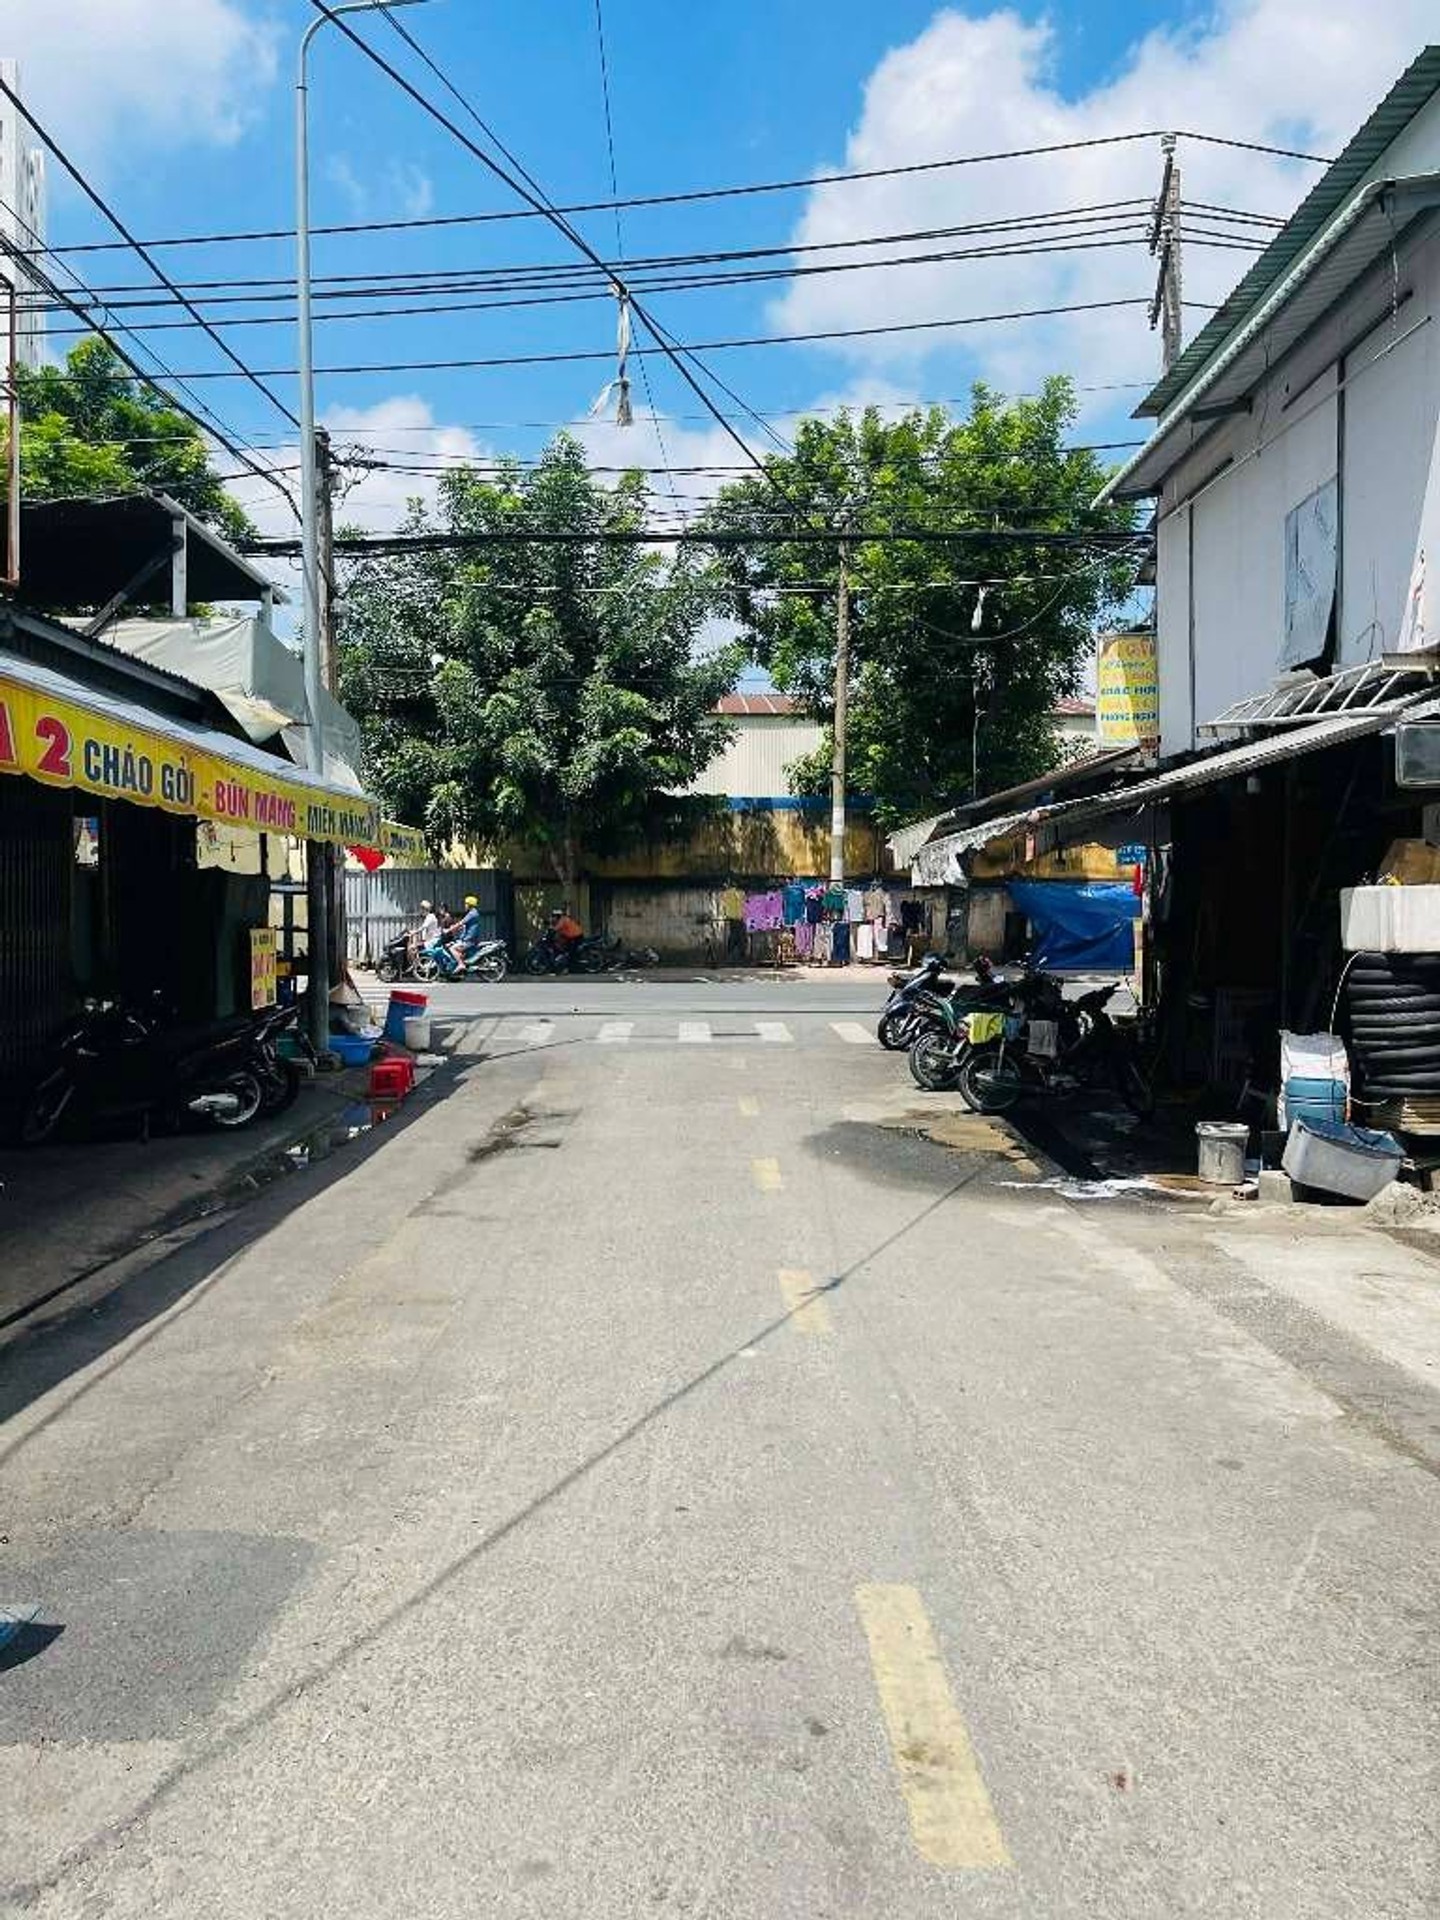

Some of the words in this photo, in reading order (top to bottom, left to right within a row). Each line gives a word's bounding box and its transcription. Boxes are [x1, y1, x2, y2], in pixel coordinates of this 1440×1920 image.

[35, 714, 72, 777] 2
[84, 738, 153, 795] CHÁO
[161, 756, 195, 806] GỎI
[215, 778, 249, 818] BÚN
